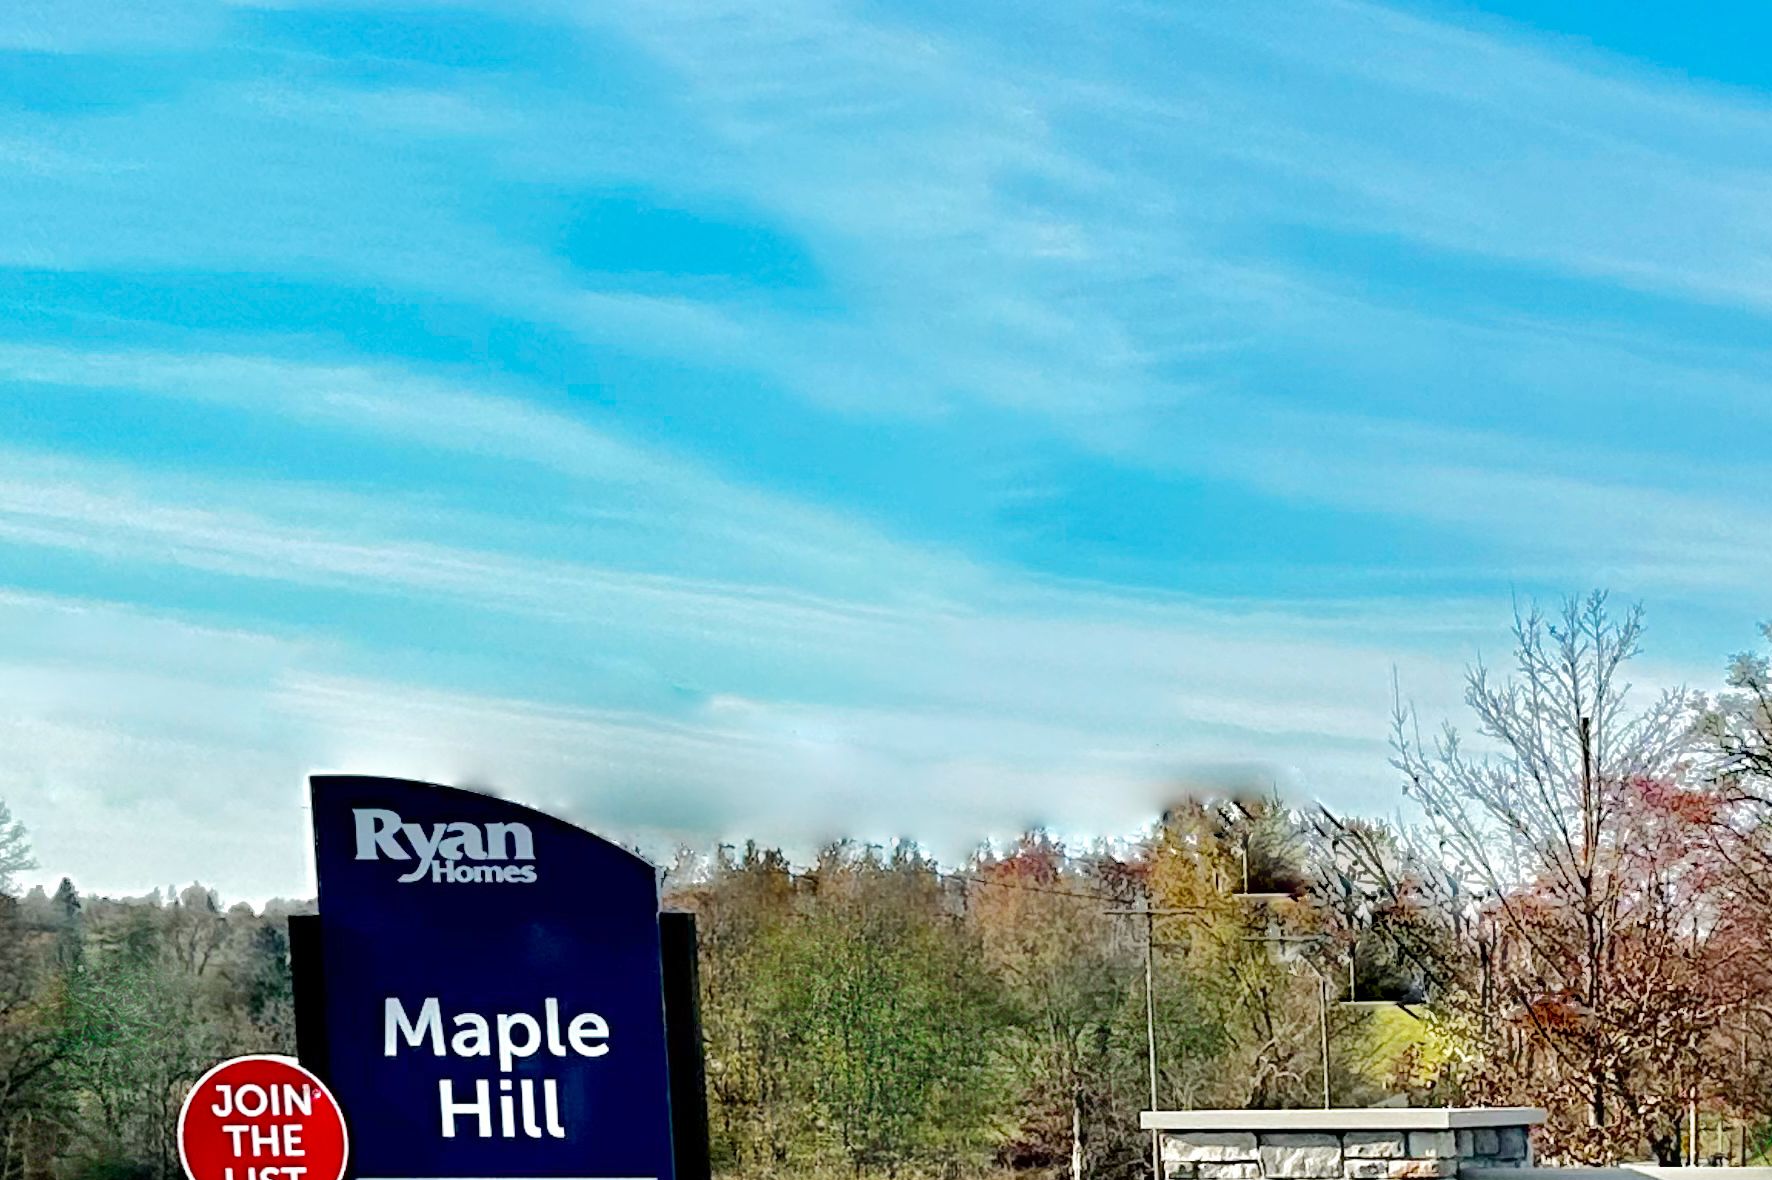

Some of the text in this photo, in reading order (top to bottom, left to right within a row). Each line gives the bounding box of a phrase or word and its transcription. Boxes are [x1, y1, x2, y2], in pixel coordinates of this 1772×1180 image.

[352, 808, 537, 883] Ryan
[431, 859, 538, 883] Homes
[384, 997, 610, 1073] Maple
[211, 1083, 313, 1118] JOIN
[438, 1079, 566, 1139] Hill
[222, 1123, 306, 1158] THE
